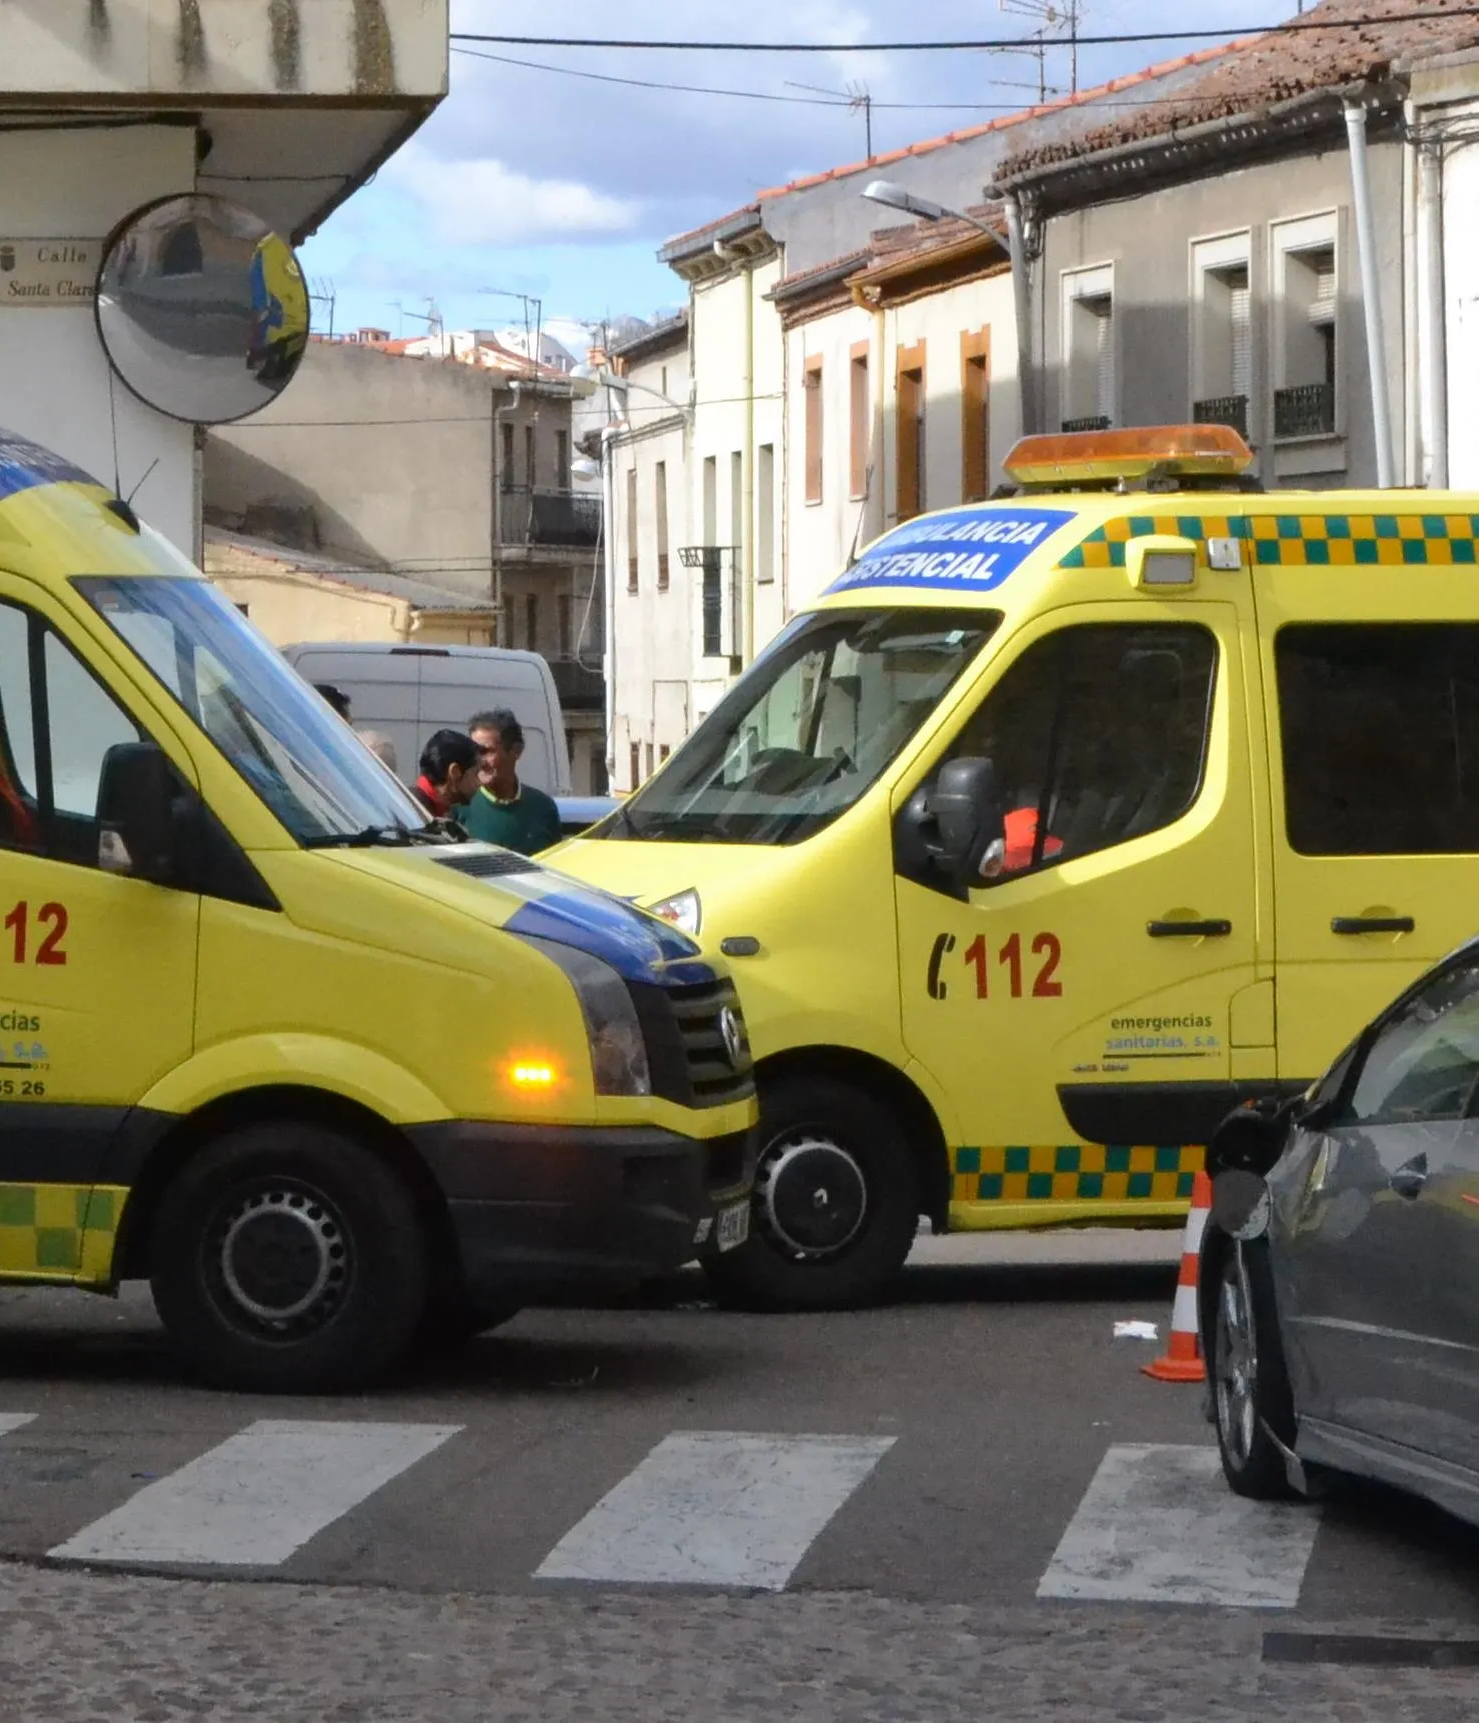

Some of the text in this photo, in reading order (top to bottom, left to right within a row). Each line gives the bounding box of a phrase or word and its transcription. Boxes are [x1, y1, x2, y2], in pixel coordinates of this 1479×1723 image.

[37, 246, 87, 263] Calle
[7, 280, 51, 297] Santa
[964, 931, 1063, 999] 112
[1110, 1013, 1213, 1032] emergencias
[22, 1081, 45, 1095] 26
